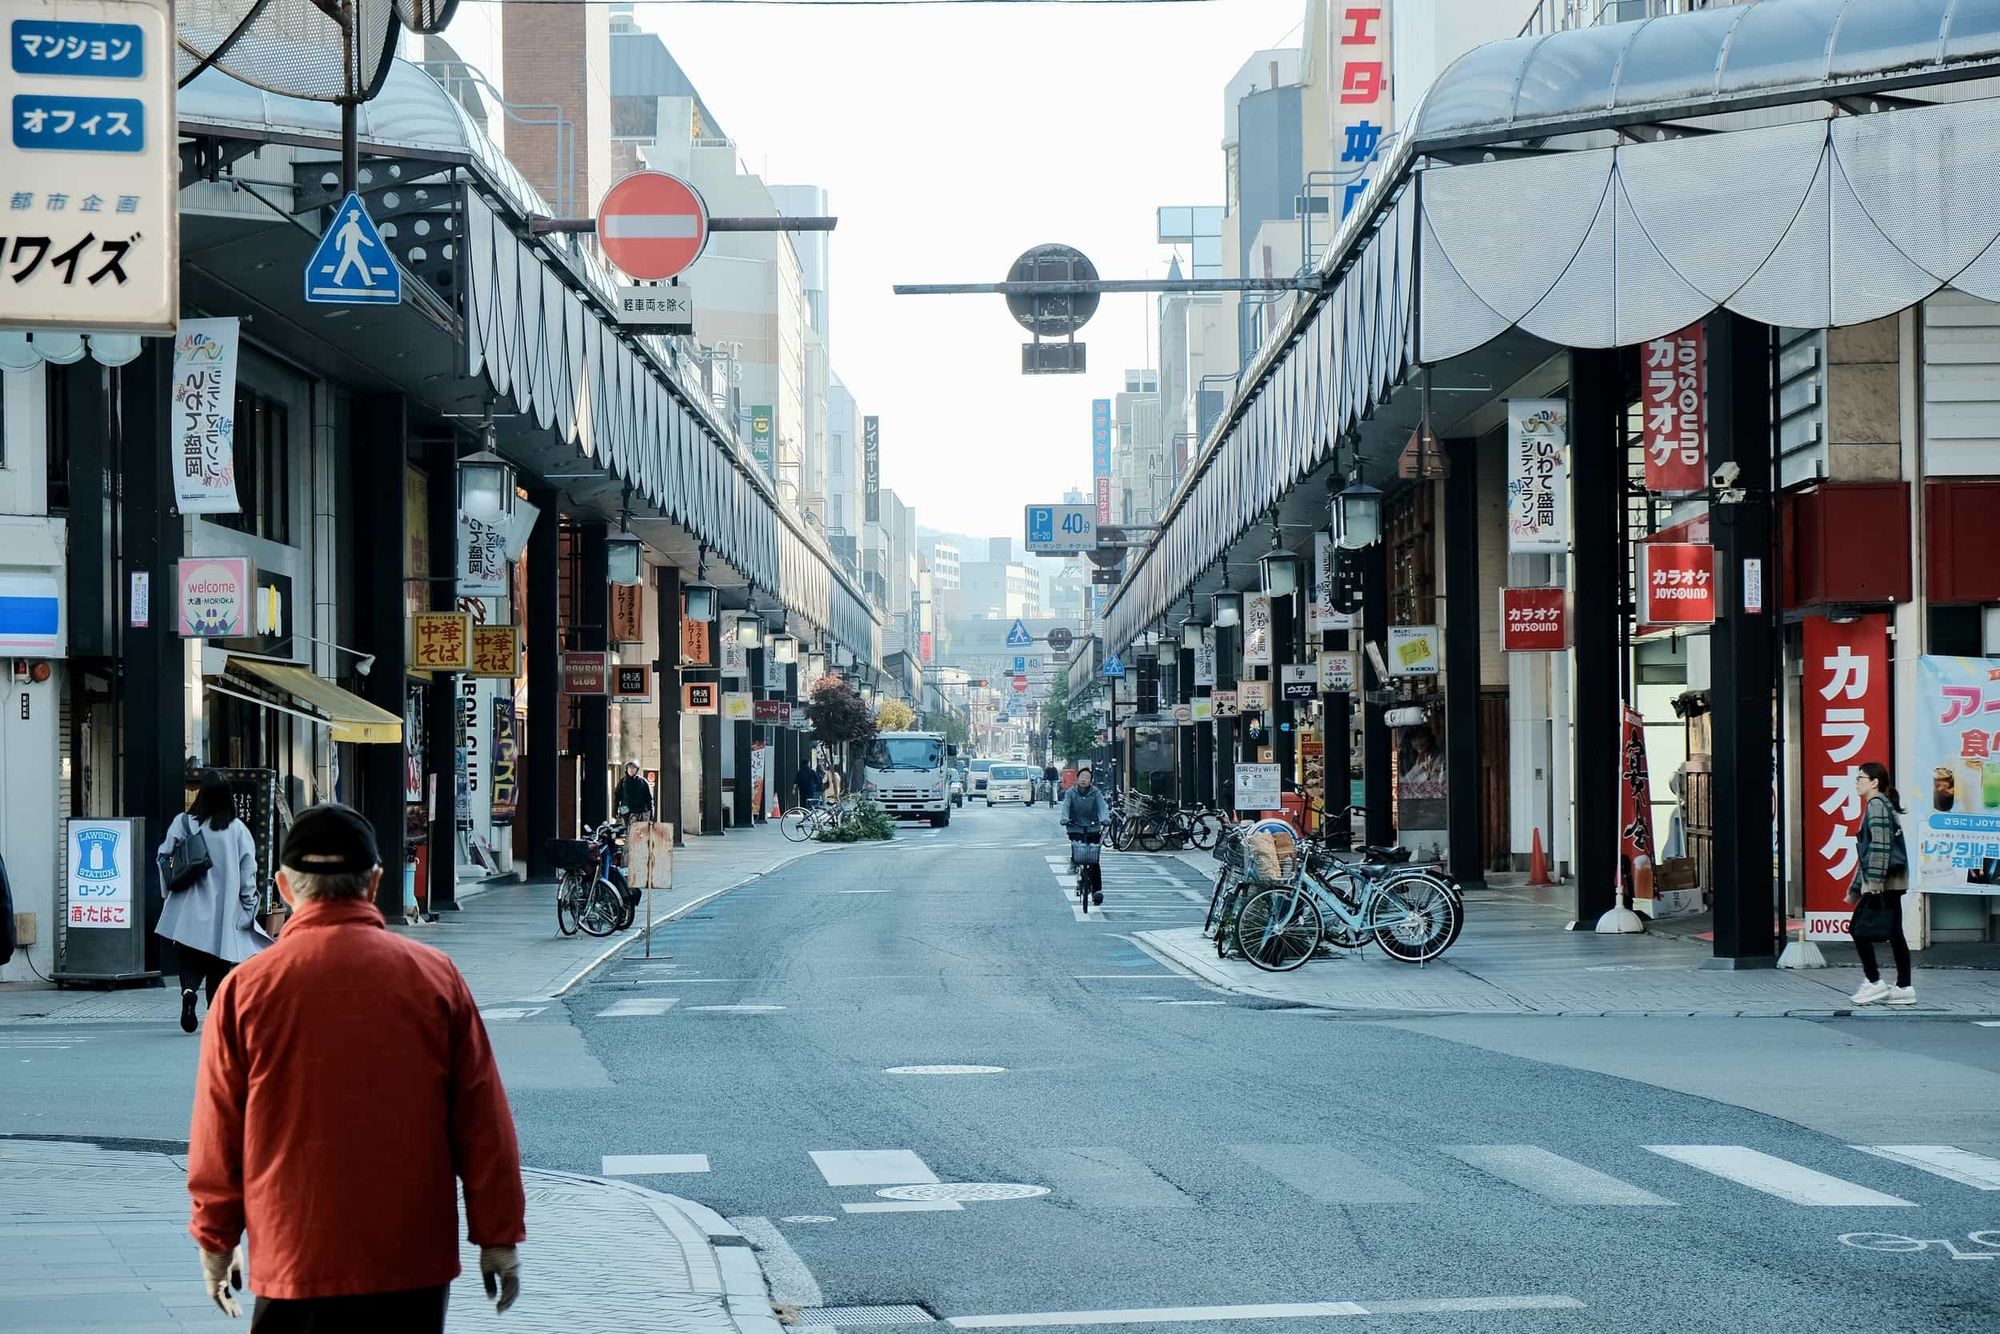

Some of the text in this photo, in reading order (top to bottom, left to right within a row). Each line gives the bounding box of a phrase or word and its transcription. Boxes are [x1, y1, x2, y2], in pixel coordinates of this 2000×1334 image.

[20, 34, 132, 62] マンション
[22, 108, 132, 137] オフィス
[10, 191, 140, 214] 都市企画
[623, 298, 686, 312] 軽車両を除く
[1648, 337, 1679, 468] カラオケ
[1677, 336, 1699, 466] JOYSOUND
[866, 420, 878, 494] レインボービル
[1521, 441, 1534, 527] シティマラソン
[1537, 441, 1554, 527] いわて盛岡
[1036, 510, 1048, 529] P
[188, 580, 235, 593] welcome
[1652, 569, 1710, 585] カラオケ
[1655, 587, 1708, 599] JOYSOUND
[1508, 607, 1561, 621] カラオケ
[420, 621, 462, 642] 中華
[1511, 623, 1558, 632] JOYSOUND
[420, 642, 462, 662] そば
[474, 632, 513, 653] 中華
[475, 651, 513, 671] そば
[622, 672, 640, 682] 快活
[692, 689, 707, 697] 快活
[1819, 646, 1870, 881] カラオケ
[79, 831, 116, 842] LAWSON
[1923, 840, 1999, 858] レンタル品
[79, 868, 115, 878] STATION
[79, 885, 117, 896] ローソン
[71, 905, 125, 922] 酒・たばこ
